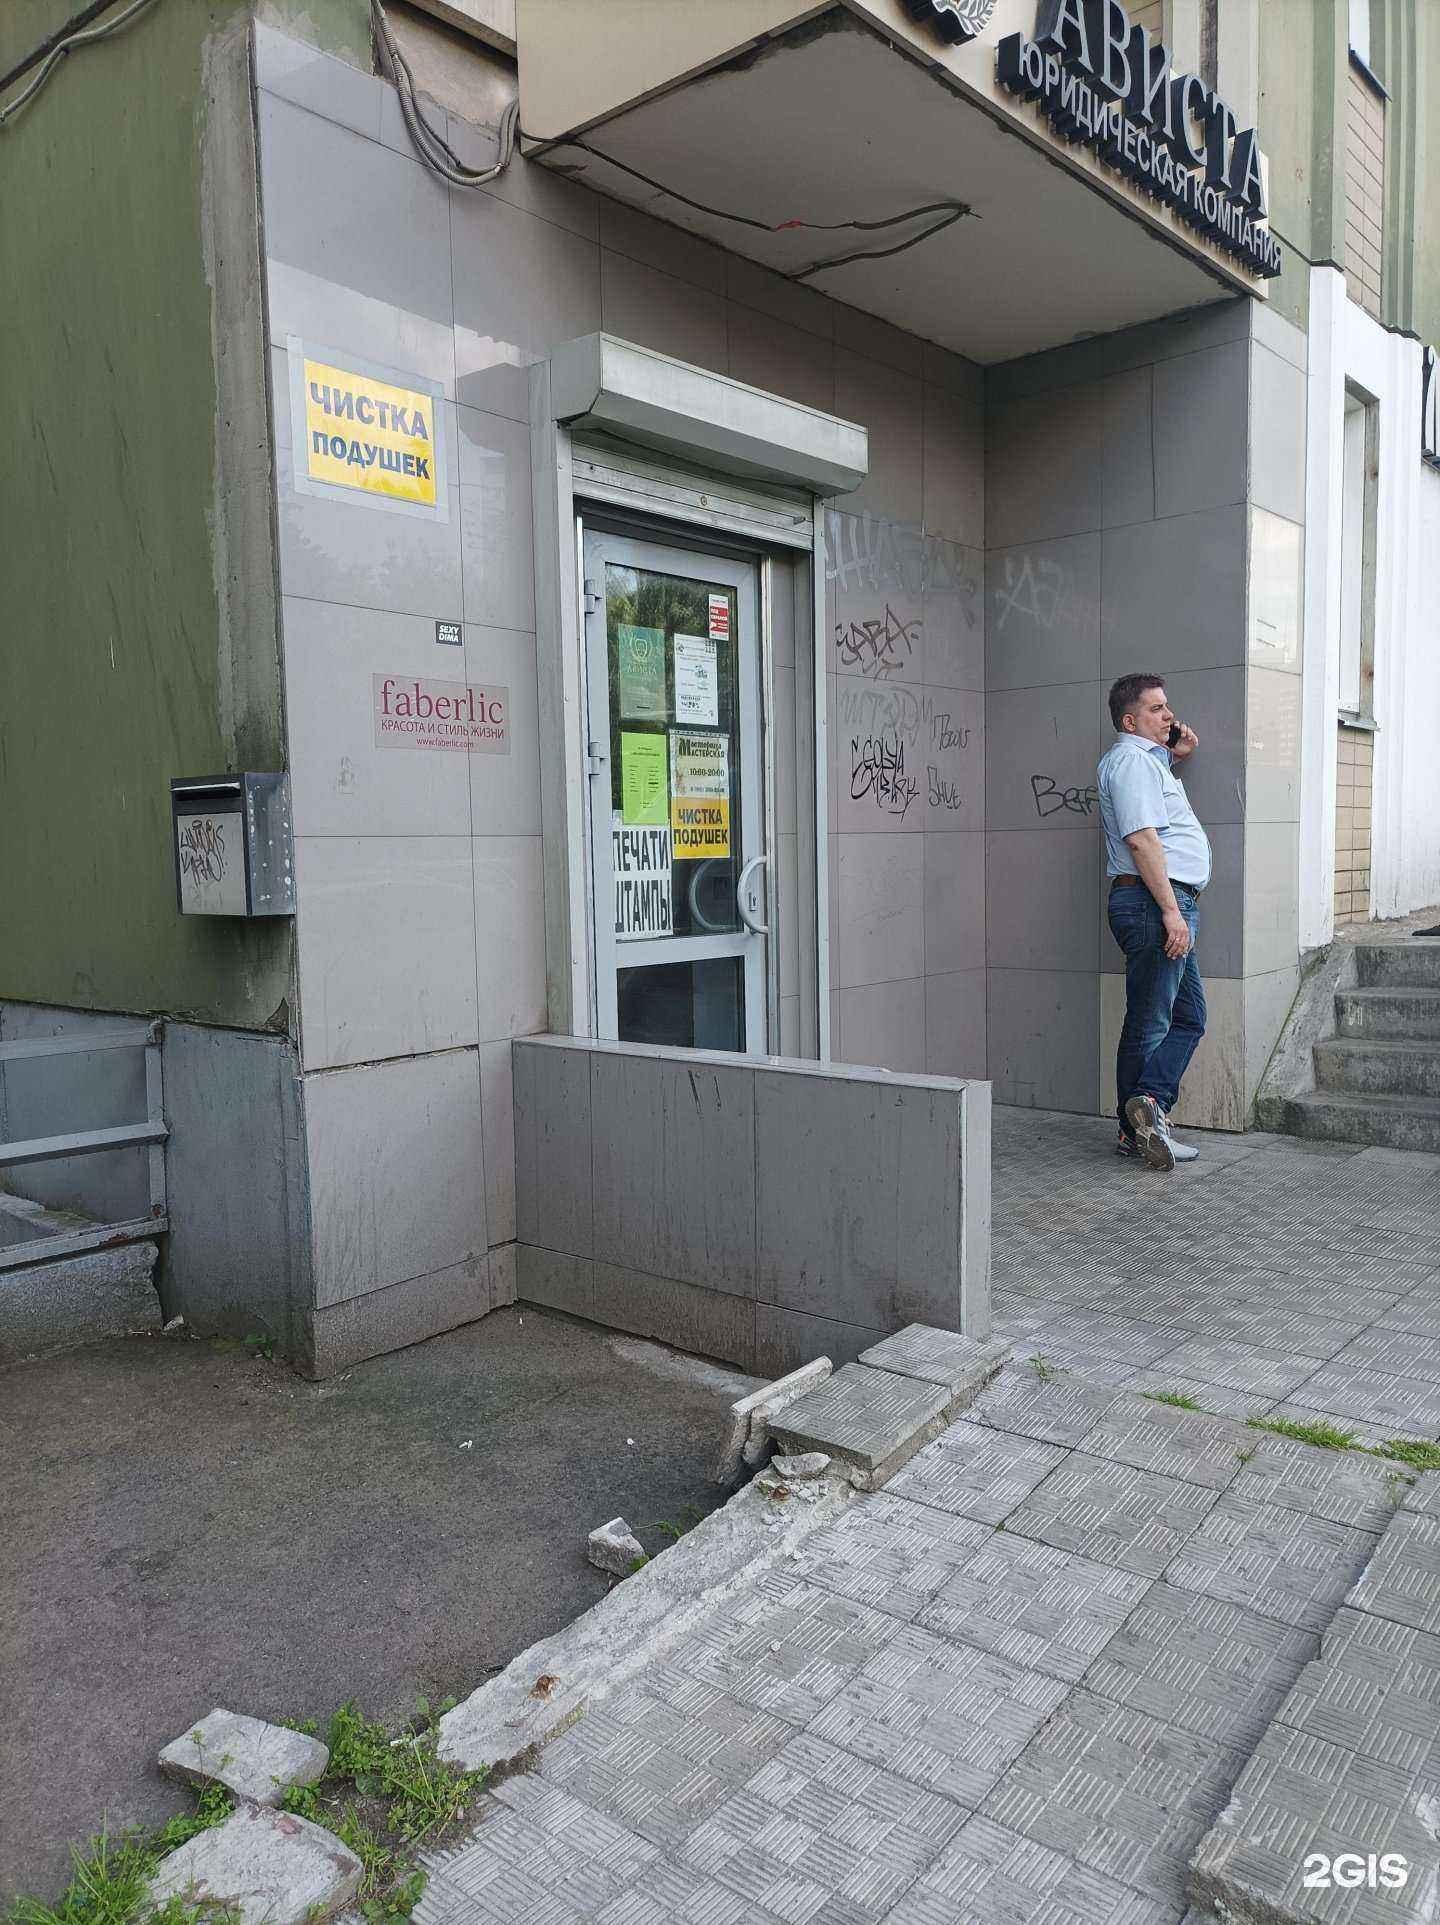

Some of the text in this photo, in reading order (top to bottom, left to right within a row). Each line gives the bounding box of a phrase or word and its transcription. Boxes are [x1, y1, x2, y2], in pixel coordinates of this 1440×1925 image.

[1051, 0, 1268, 218] АВИСТА
[1018, 32, 1283, 274] ЮРИДИЧЕСКАЯ КОМПАНИЯ
[310, 382, 429, 440] ЧИСТКА
[312, 431, 430, 480] ПОДУШЕК
[438, 633, 460, 642] DIMA
[439, 625, 460, 635] SEXY
[381, 680, 504, 724] faberlic
[381, 719, 505, 739] КРАСОТА И СТИЛЬ ЖИЗНИ
[416, 738, 474, 749] www.faberlic.com
[677, 808, 723, 825] ЧИСТКА
[612, 830, 669, 872] ПЕЧАТИ
[673, 828, 728, 847] ПОДУШЕК
